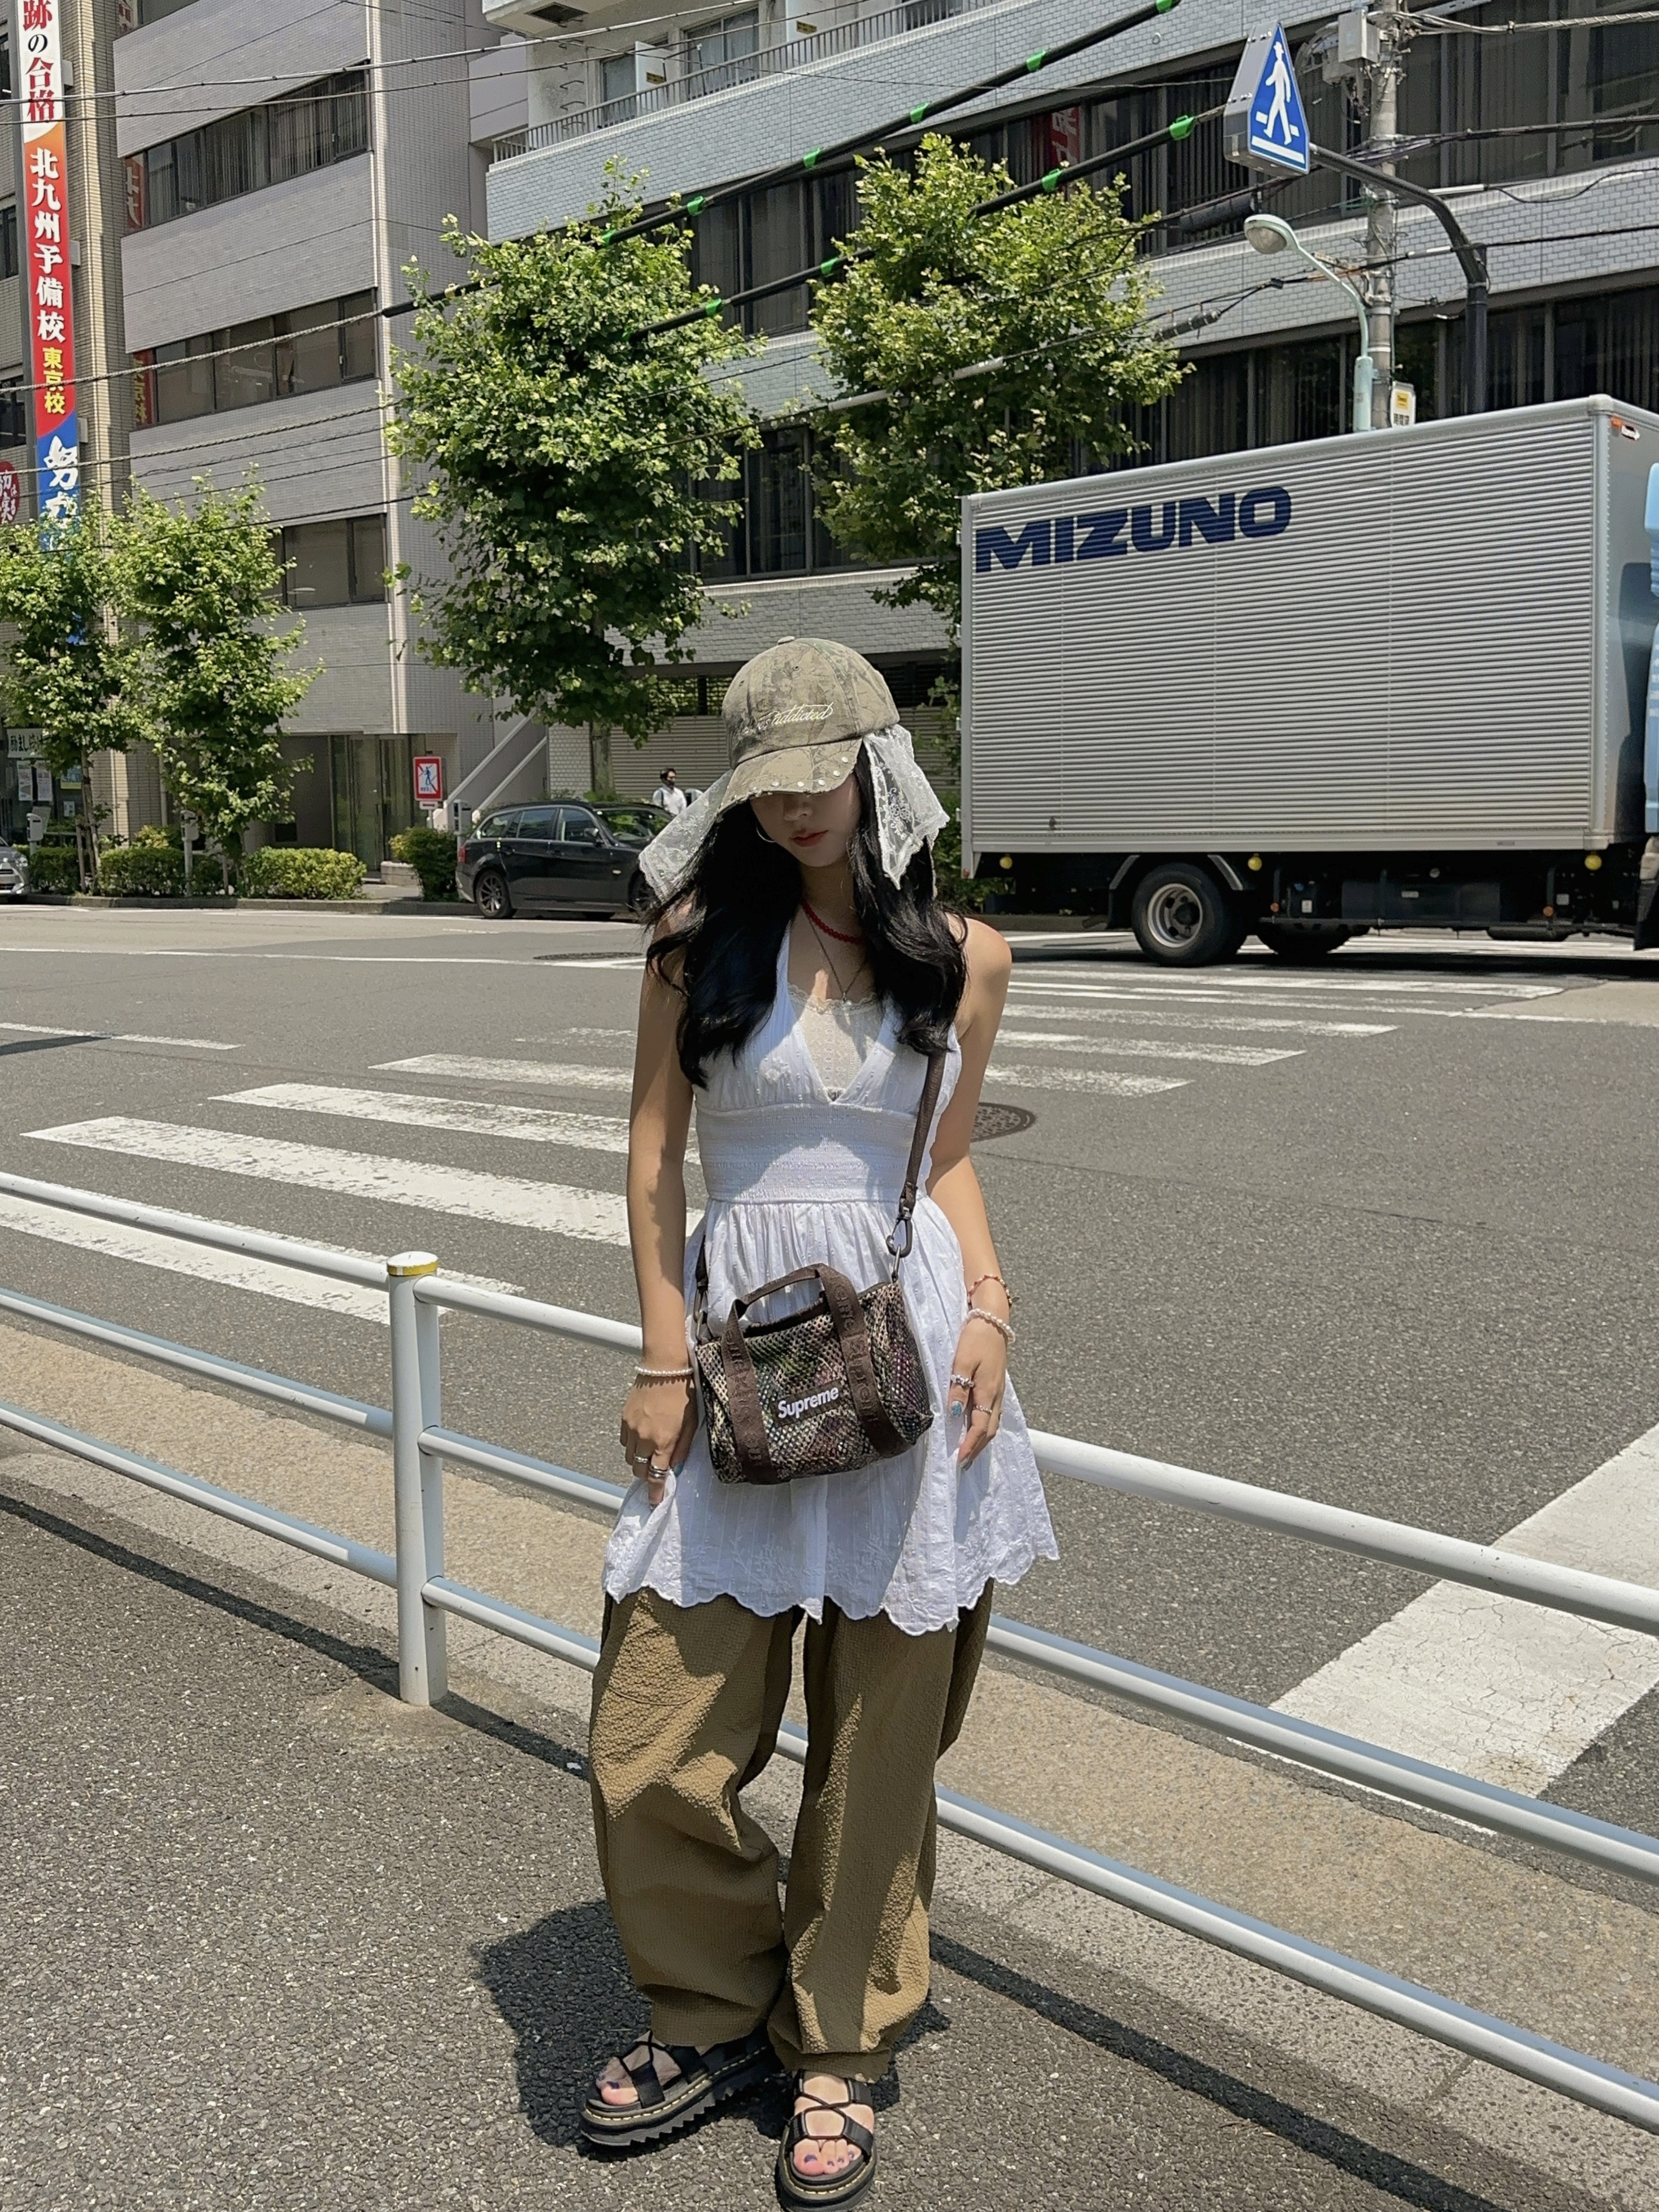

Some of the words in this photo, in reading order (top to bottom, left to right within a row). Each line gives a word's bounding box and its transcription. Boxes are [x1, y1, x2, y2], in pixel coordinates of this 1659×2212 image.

[23, 0, 54, 123] 跡の合格
[30, 147, 66, 344] 北九州予備校
[42, 347, 66, 415] 東京校
[976, 486, 1292, 573] MIZUNO
[778, 1387, 839, 1419] Supreme
